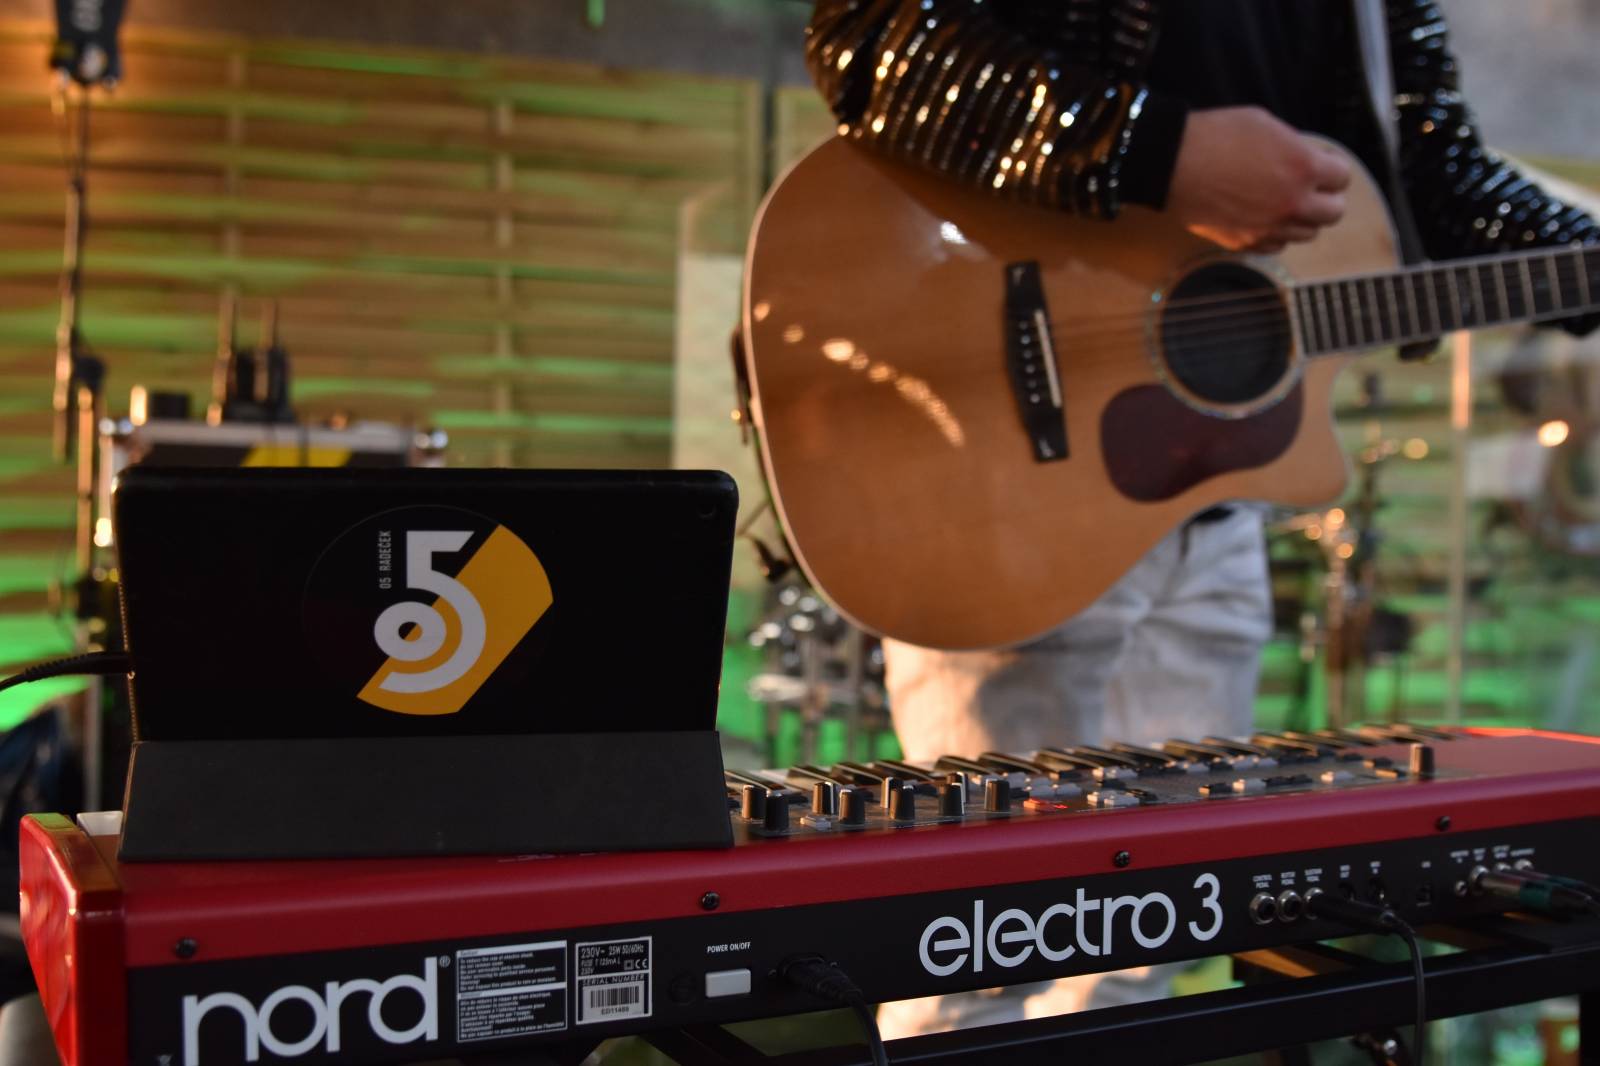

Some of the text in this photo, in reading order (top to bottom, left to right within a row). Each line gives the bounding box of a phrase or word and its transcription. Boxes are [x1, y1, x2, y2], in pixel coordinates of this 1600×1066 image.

[707, 941, 751, 954] POWER ON/OFF
[919, 872, 1223, 976] electro 3
[583, 974, 644, 986] SERIAL NUMBER
[182, 956, 437, 1066] nord
